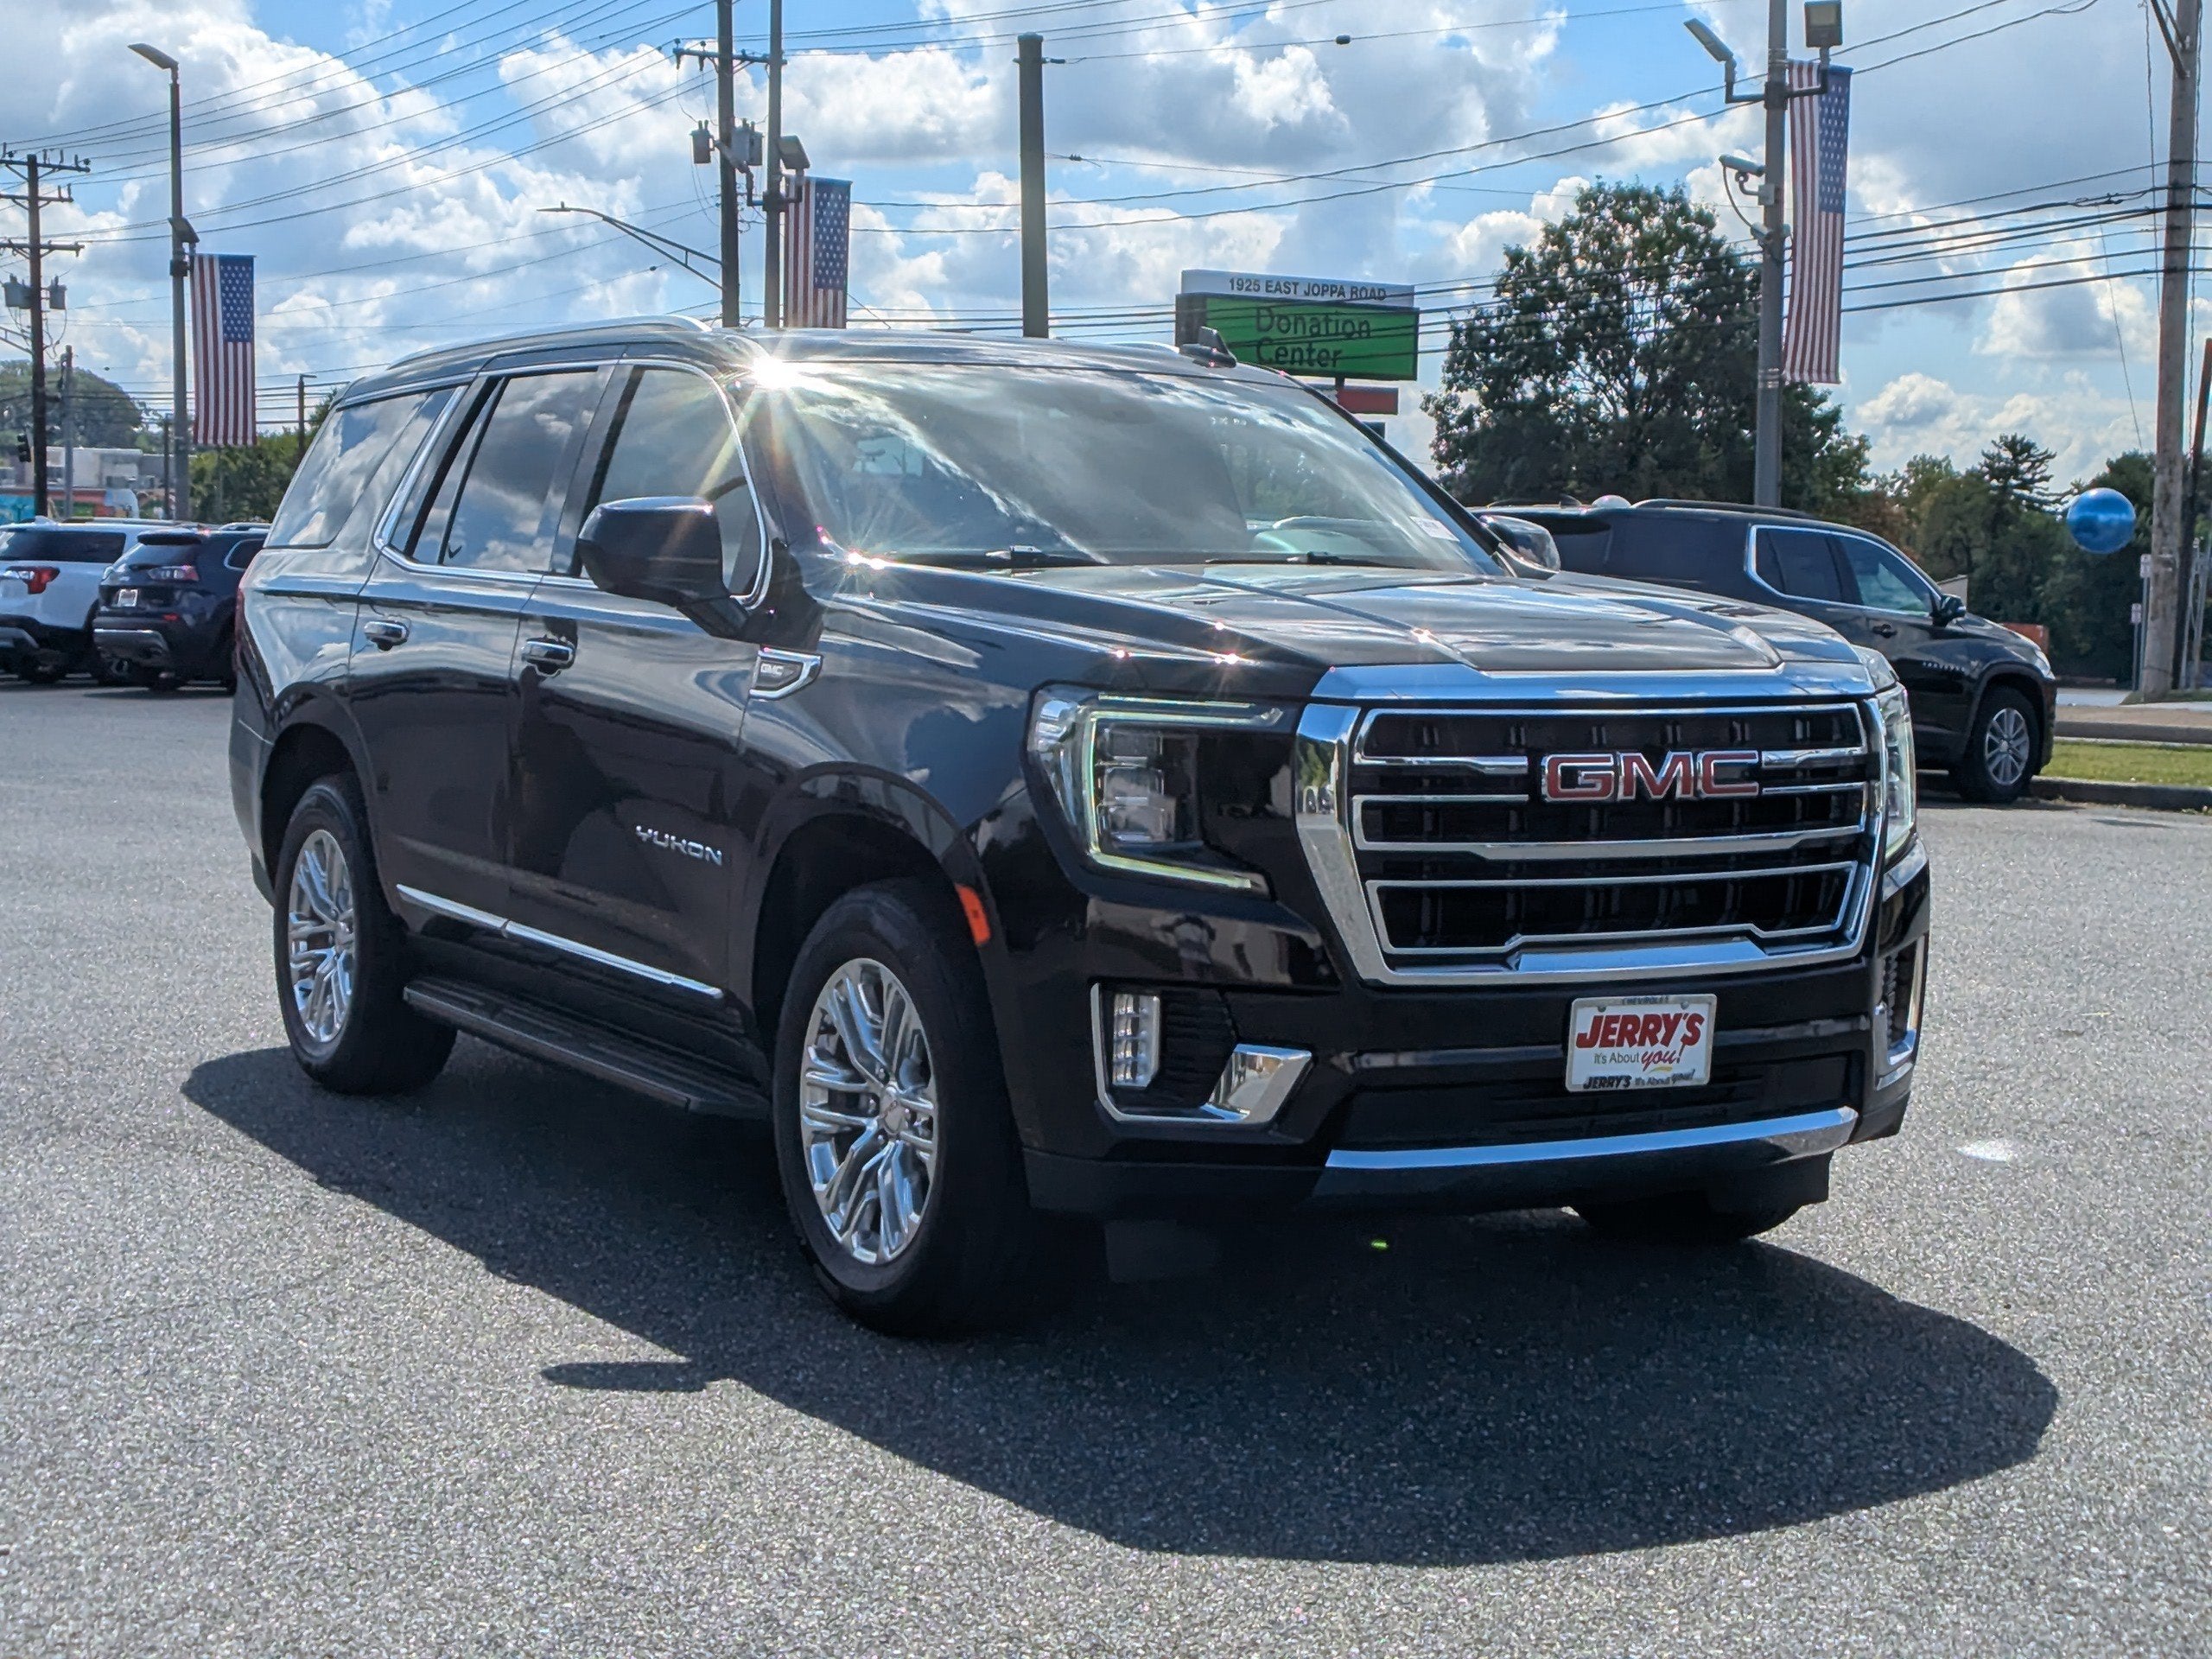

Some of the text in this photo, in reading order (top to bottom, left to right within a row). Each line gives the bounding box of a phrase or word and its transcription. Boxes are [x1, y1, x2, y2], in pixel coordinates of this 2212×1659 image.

[1229, 277, 1387, 301] 1925 EAST JOPPA ROAD
[1256, 307, 1371, 338] Donation
[1256, 337, 1342, 368] Center
[760, 663, 785, 676] GMC
[1541, 749, 1759, 802] GMC
[635, 825, 723, 867] YUKON
[1575, 1012, 1705, 1048] JERRY'S
[1609, 1051, 1639, 1063] About
[1640, 1045, 1685, 1071] you!
[1583, 1075, 1632, 1089] JERRY'S
